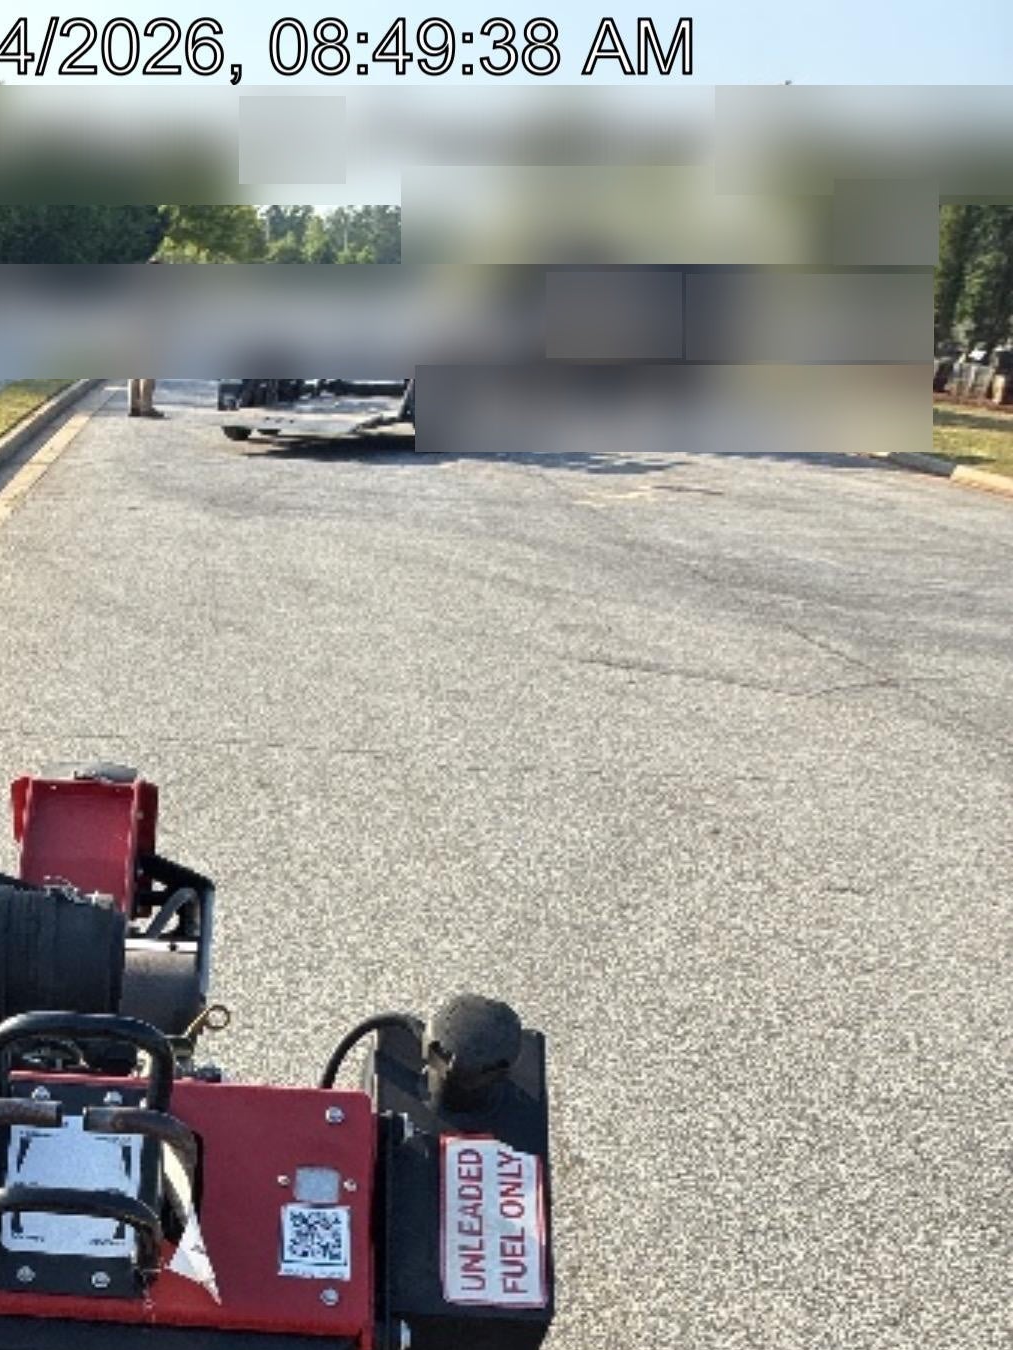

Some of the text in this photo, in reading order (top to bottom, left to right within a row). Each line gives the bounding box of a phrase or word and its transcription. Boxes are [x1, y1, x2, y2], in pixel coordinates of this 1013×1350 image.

[457, 1148, 487, 1291] UNLEADED
[496, 1149, 528, 1294] FUEL ONLY
